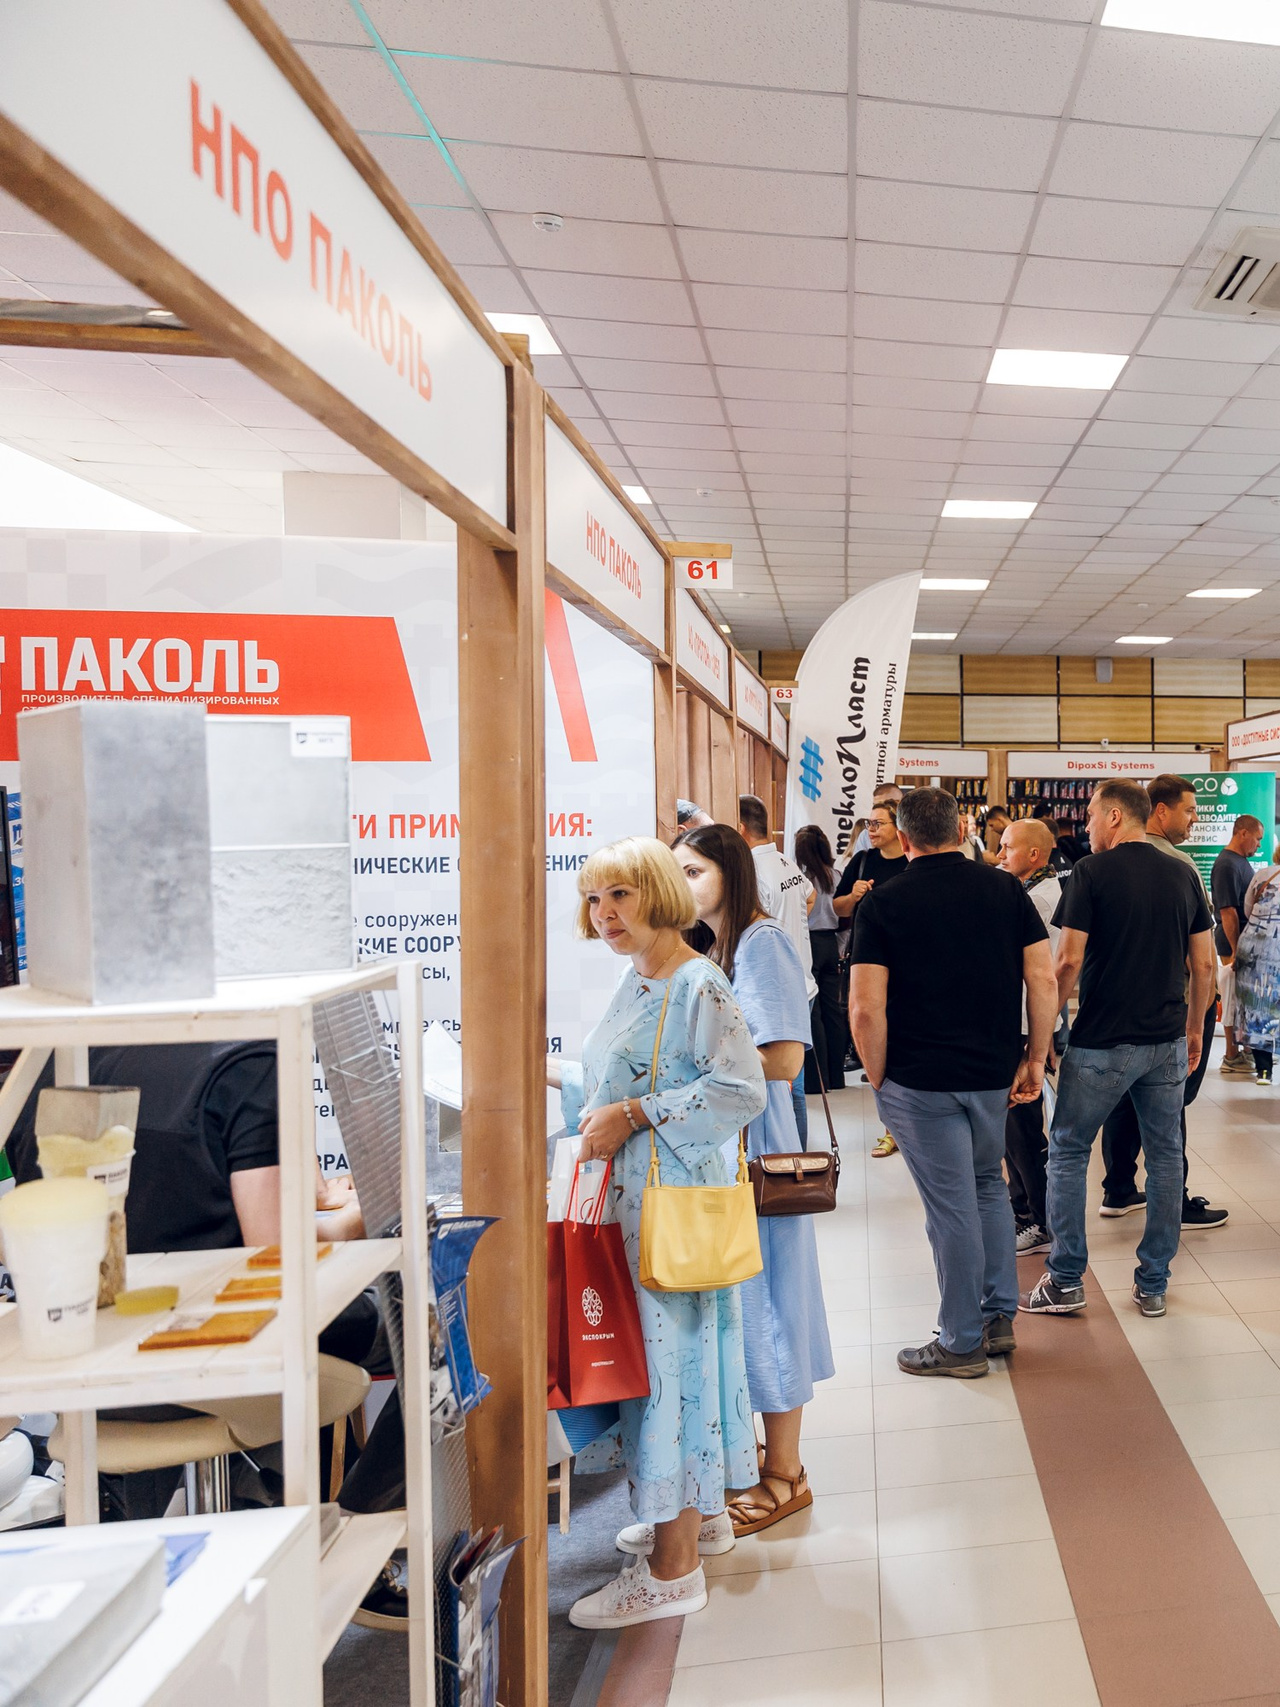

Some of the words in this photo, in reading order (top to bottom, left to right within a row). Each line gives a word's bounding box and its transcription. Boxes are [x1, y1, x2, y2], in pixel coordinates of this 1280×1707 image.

[189, 77, 294, 262] НПО
[309, 211, 433, 403] ПАКОЛЬ
[586, 510, 607, 567] НПО
[609, 535, 642, 600] ПАКОЛЬ
[687, 560, 718, 580] 61
[20, 636, 280, 693] ПАКОЛЬ
[776, 688, 793, 699] 63
[880, 661, 897, 735] арматуры
[1231, 736, 1240, 747] ООО
[832, 656, 871, 857] теклоПласт
[899, 758, 940, 768] Systems
[1067, 761, 1108, 771] DipoxSi
[1111, 761, 1155, 771] Systems
[1216, 804, 1228, 812] ОТ
[364, 914, 461, 931] сооружен
